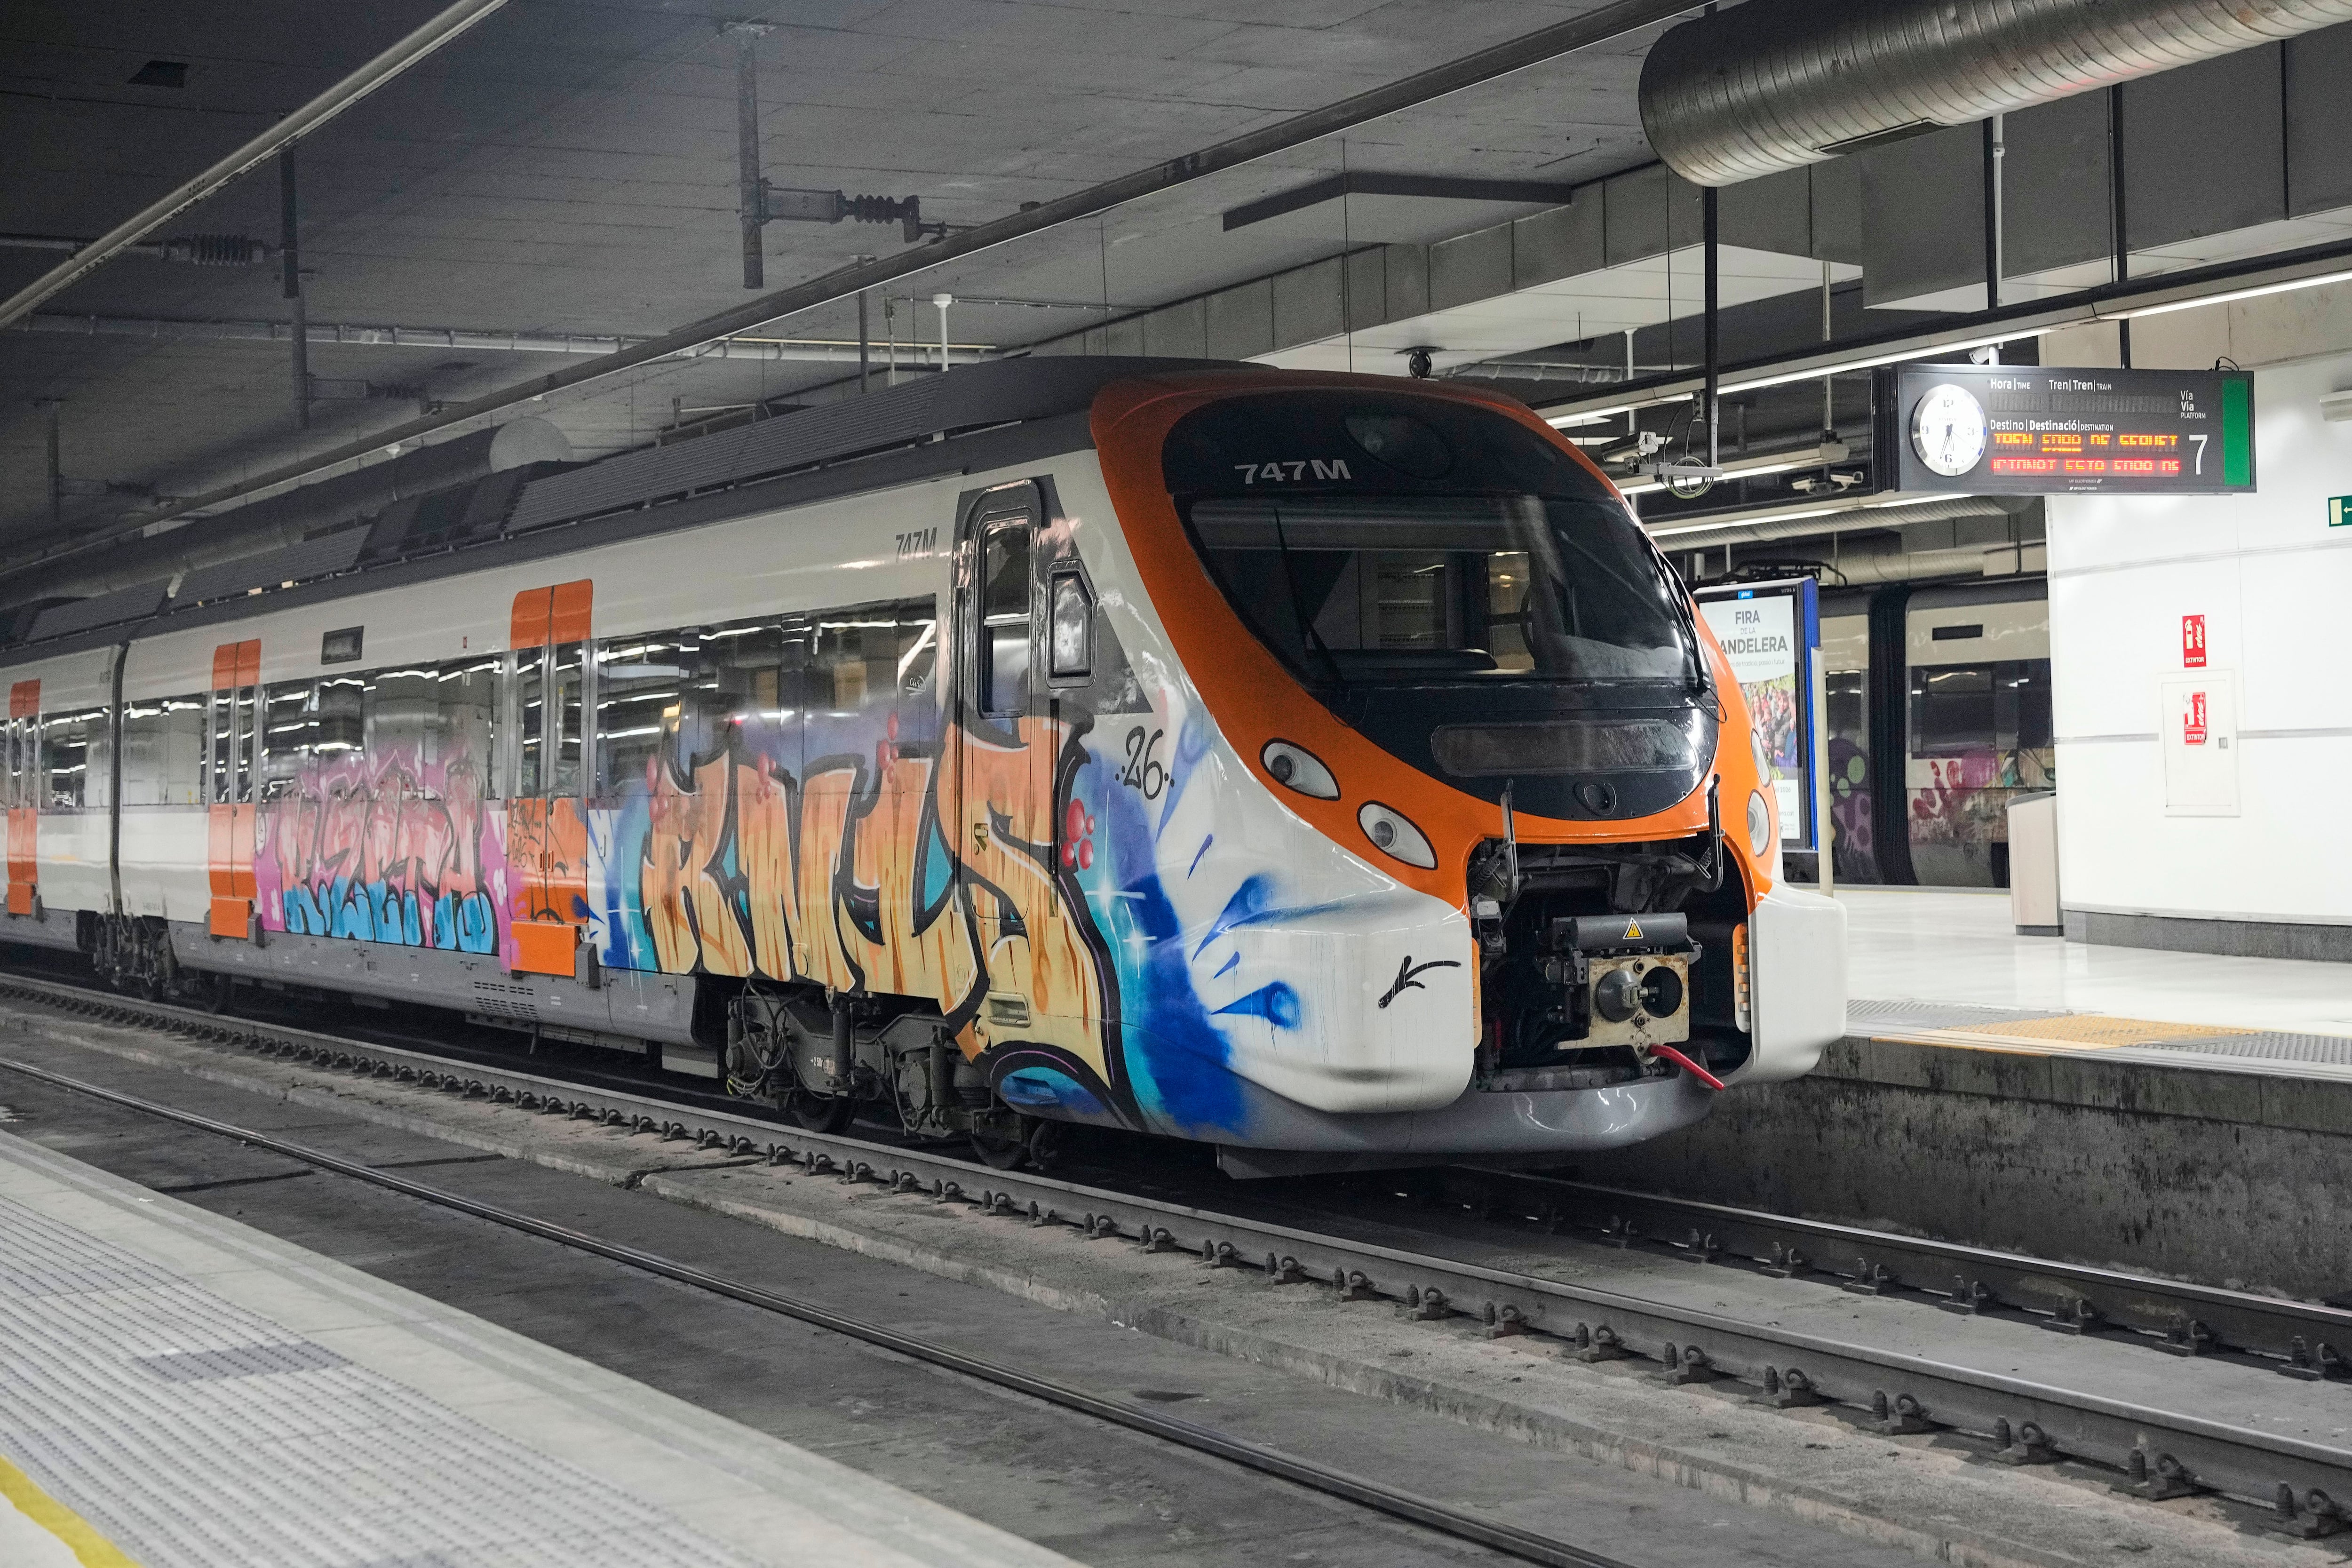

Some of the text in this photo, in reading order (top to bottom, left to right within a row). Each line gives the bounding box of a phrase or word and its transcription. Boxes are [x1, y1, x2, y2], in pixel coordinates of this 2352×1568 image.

[1991, 378, 2011, 390] Hora
[2049, 379, 2068, 390] Tren
[2073, 380, 2093, 390] Tren
[2181, 390, 2193, 400] Vía
[2181, 401, 2194, 411] Via
[1922, 426, 1929, 435] 9
[1990, 419, 2024, 430] Destino
[2029, 420, 2076, 431] Destinació
[1945, 454, 1952, 463] 6
[2189, 434, 2208, 475] 7
[1234, 459, 1351, 485] 747M
[895, 527, 938, 563] 747M
[1735, 610, 1760, 624] FIRA
[1720, 636, 1788, 655] ANDELERA
